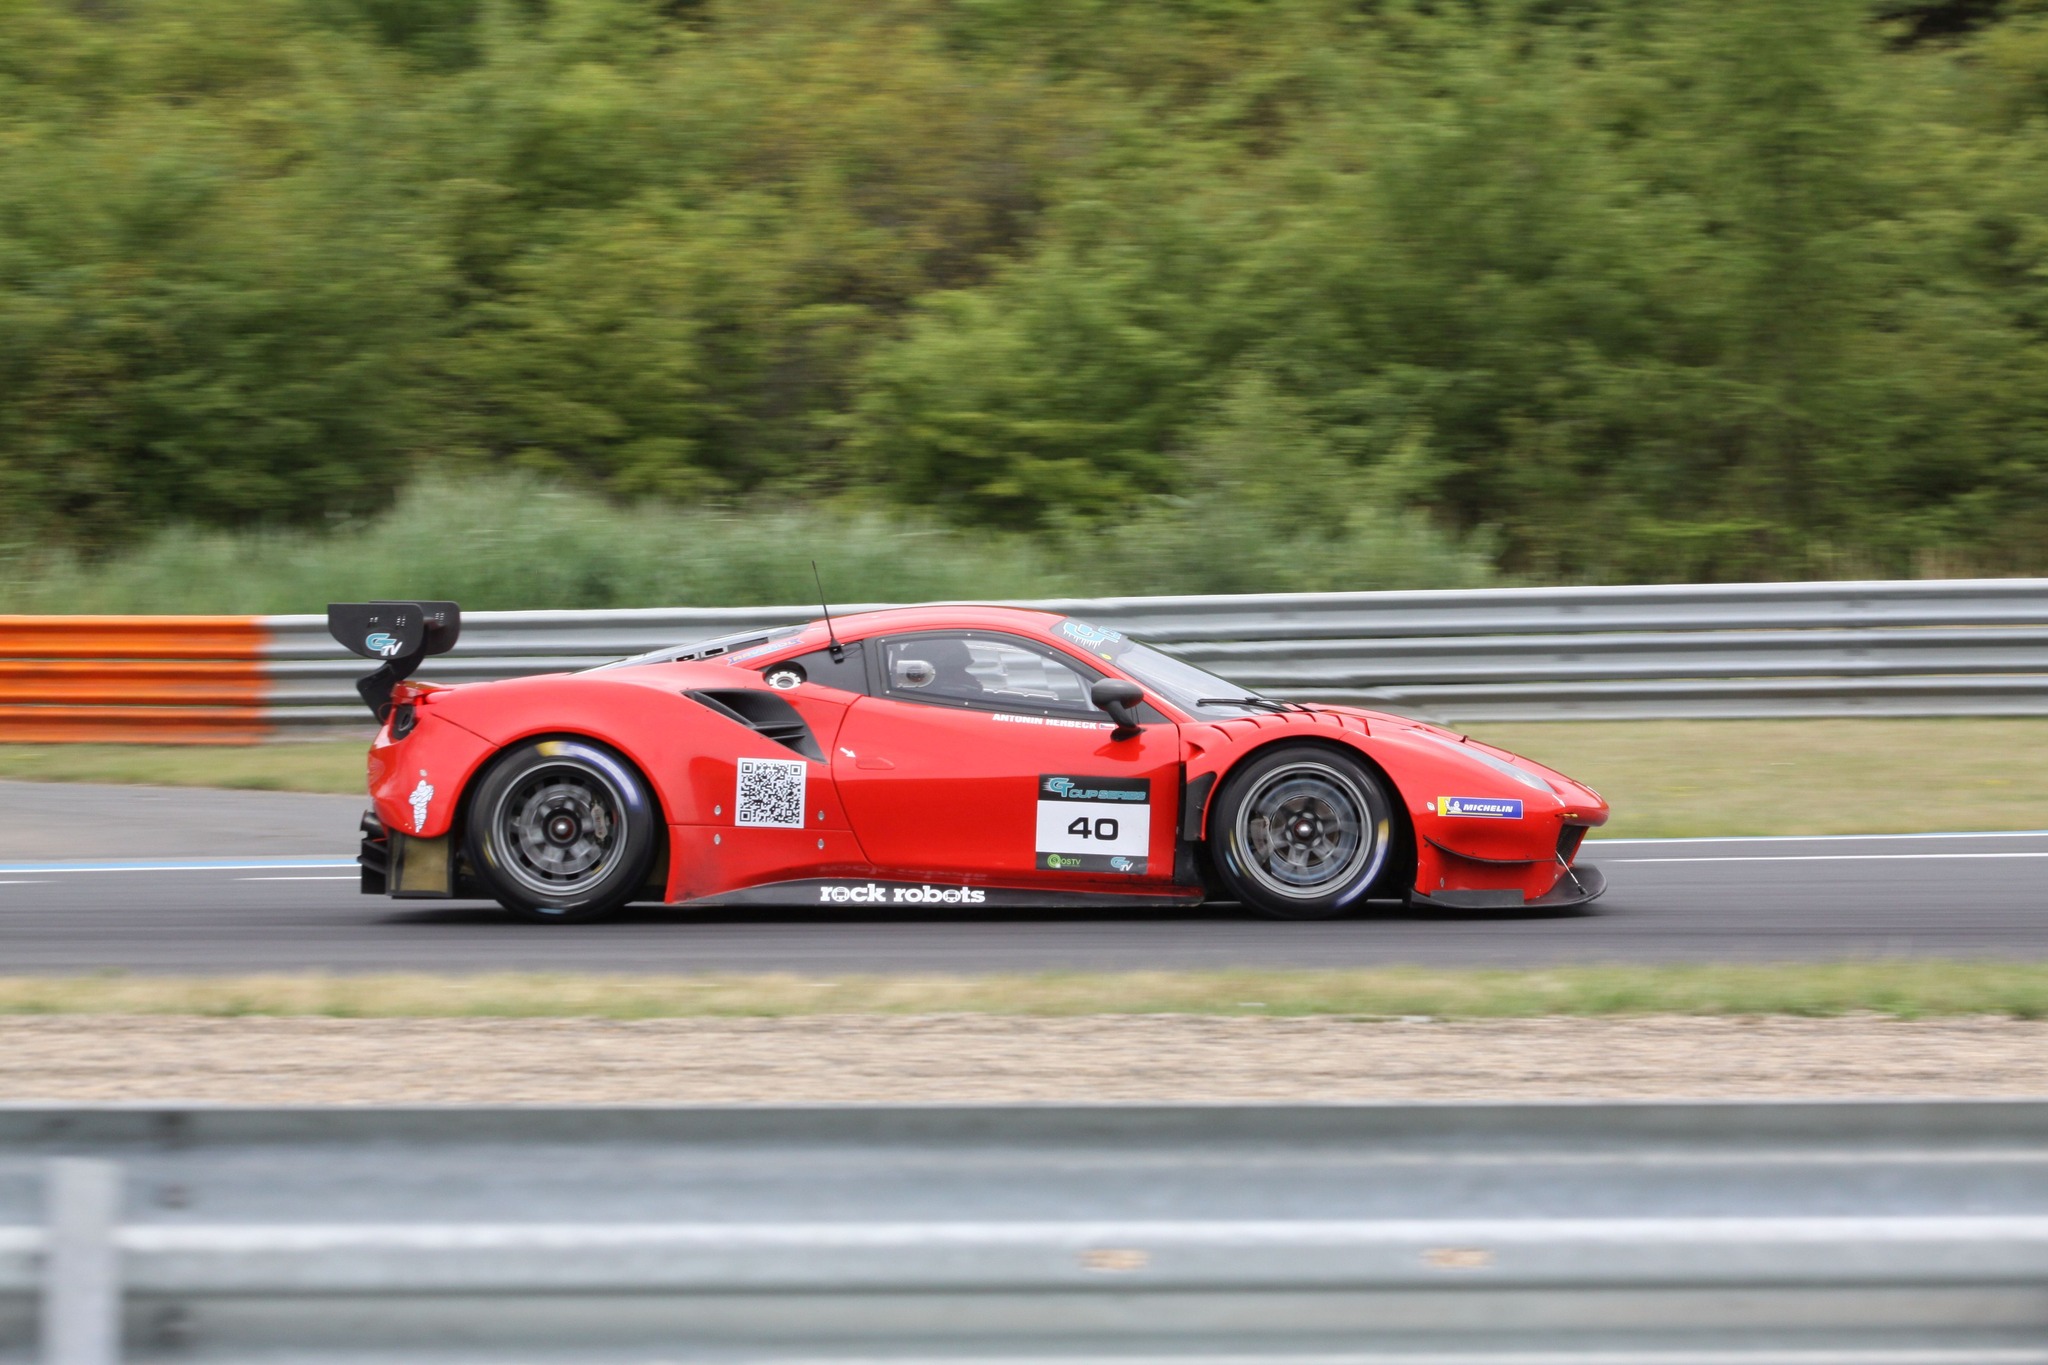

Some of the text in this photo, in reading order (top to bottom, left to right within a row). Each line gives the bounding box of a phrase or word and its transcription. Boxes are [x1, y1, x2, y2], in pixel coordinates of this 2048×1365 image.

[992, 713, 1097, 730] ANTONIN HERBECK
[1047, 777, 1146, 801] GT CUP SERIES
[1462, 804, 1514, 813] MICHELIN
[1067, 816, 1119, 841] 40
[820, 883, 986, 904] rock robots
